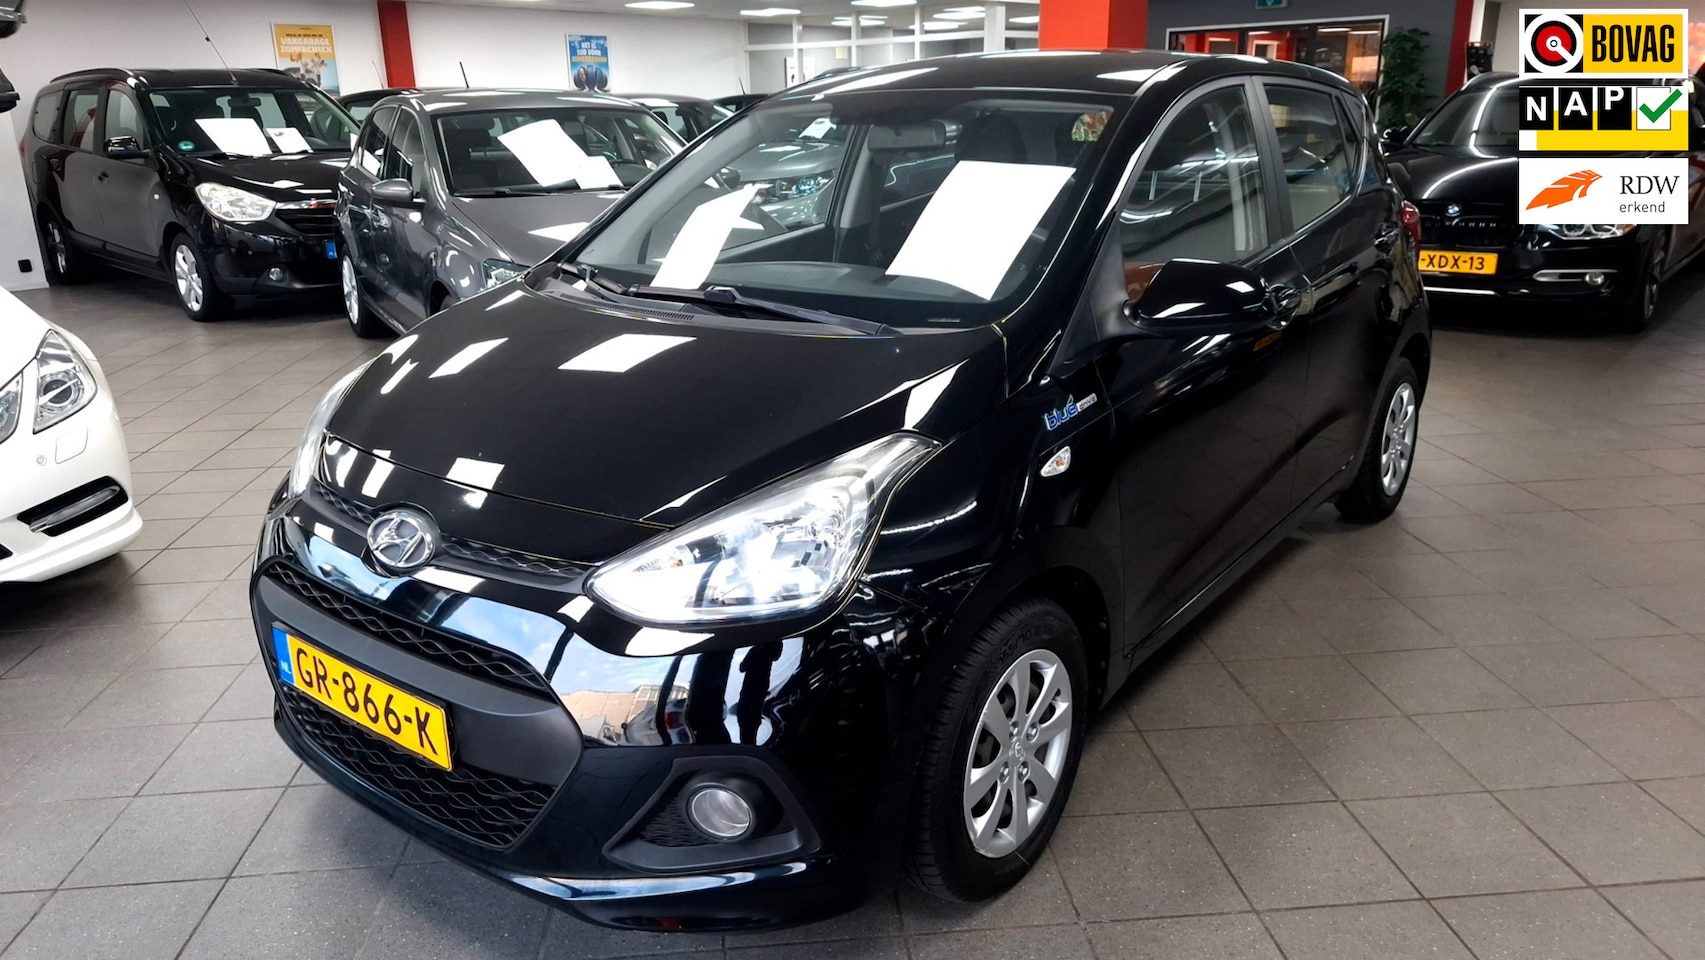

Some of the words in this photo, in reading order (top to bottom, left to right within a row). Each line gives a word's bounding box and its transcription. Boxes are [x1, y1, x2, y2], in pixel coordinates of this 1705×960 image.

[1421, 254, 1485, 271] -XDX-13
[1044, 399, 1078, 431] blue
[296, 647, 438, 756] GR-866-K
